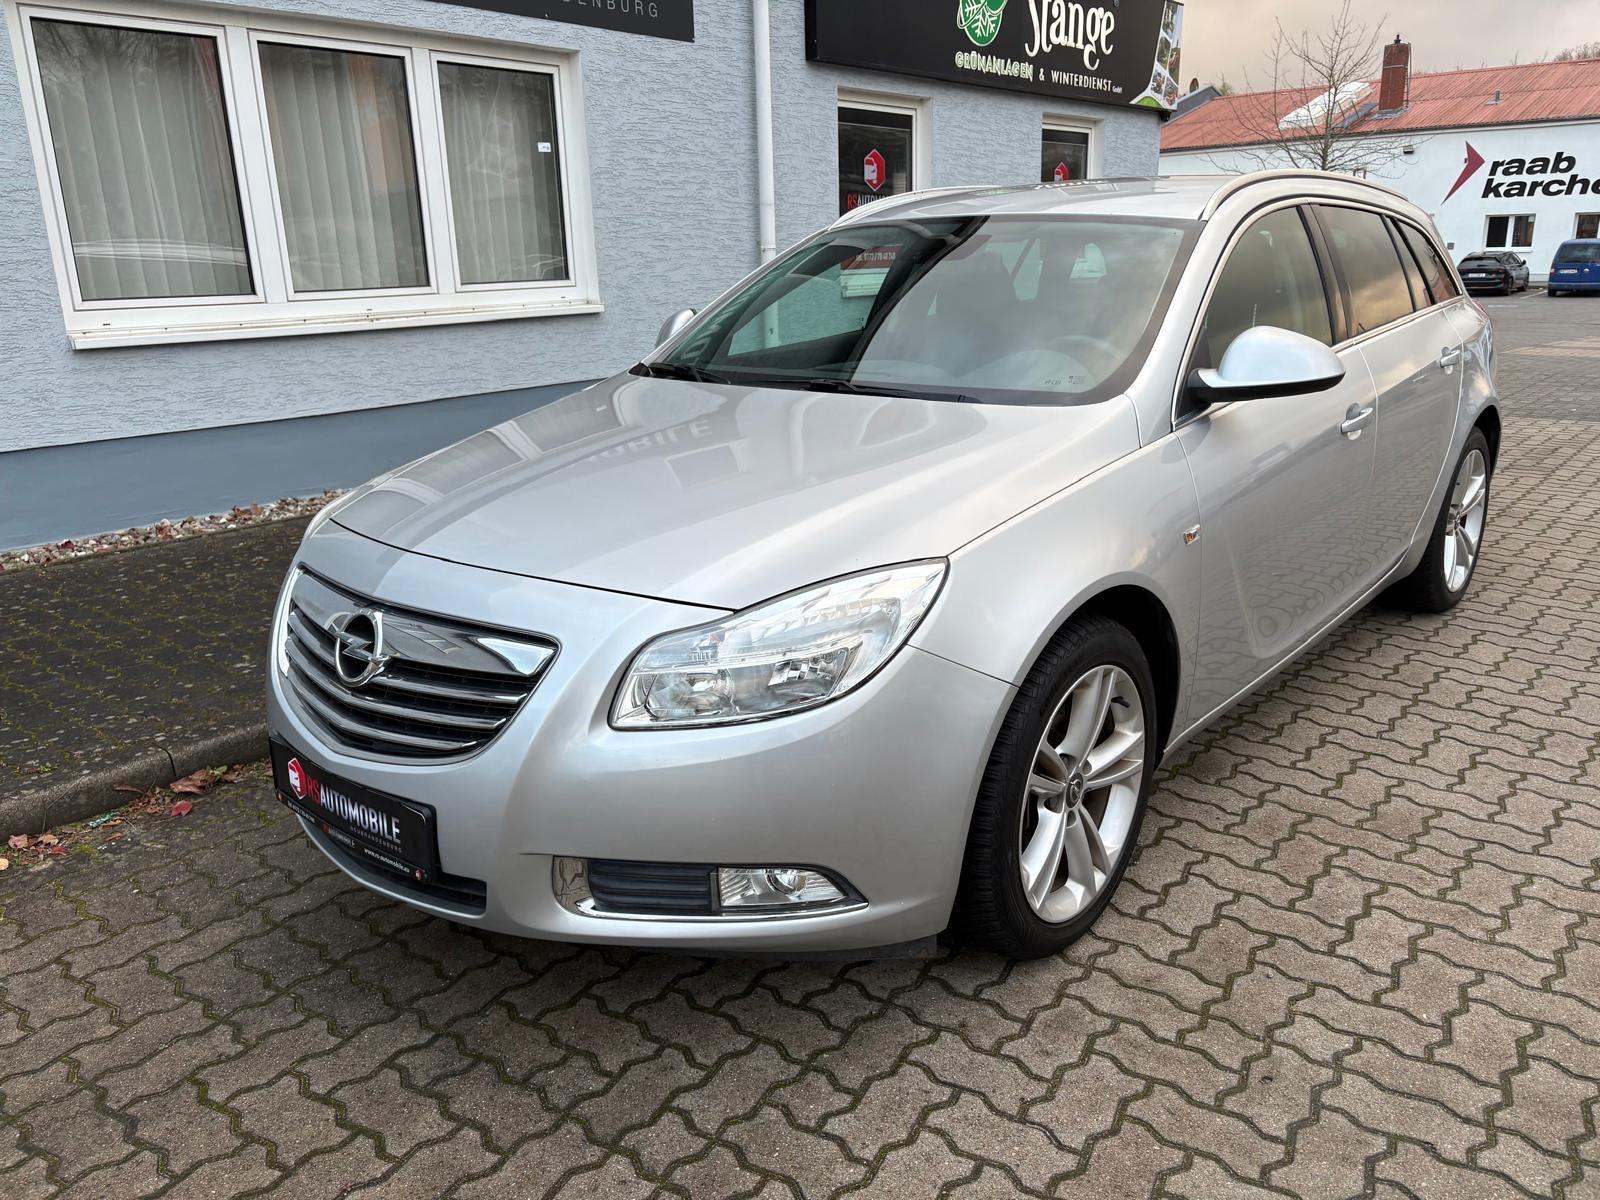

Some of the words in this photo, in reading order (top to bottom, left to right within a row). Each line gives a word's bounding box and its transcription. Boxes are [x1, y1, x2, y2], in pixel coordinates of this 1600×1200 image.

[1039, 68, 1046, 82] &
[1051, 70, 1112, 92] WINTERDIENST
[1488, 151, 1576, 177] raab
